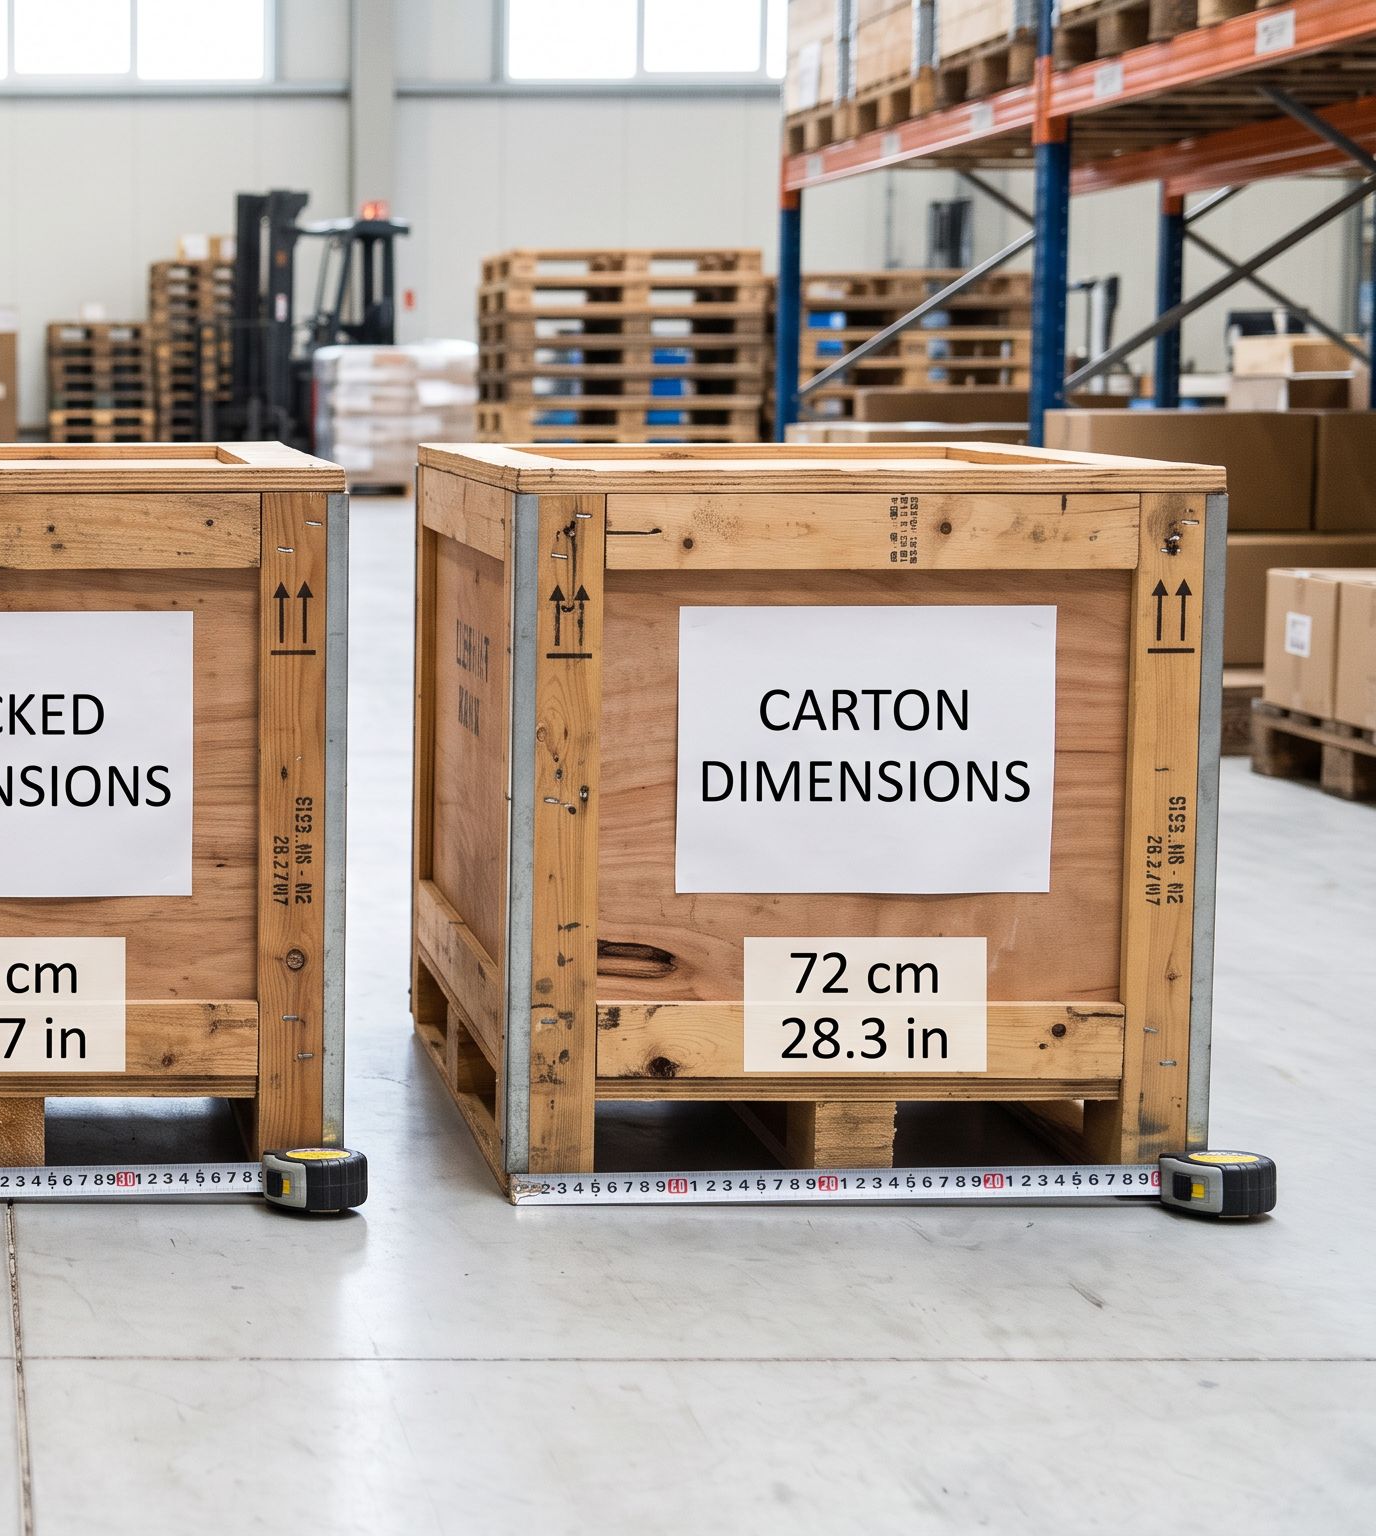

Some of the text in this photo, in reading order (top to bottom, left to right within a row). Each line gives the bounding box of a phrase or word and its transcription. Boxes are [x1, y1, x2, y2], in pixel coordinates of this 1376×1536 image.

[759, 688, 969, 732] CARTON
[701, 760, 1032, 803] DIMENSIONS
[0, 1175, 10, 1188] 2
[15, 1175, 26, 1188] 3
[31, 1175, 42, 1188] 4
[47, 1174, 58, 1187] 5
[62, 1174, 73, 1187] 6
[77, 1174, 88, 1187] 7
[93, 1173, 104, 1186] 8
[106, 1173, 116, 1186] 9
[135, 1173, 142, 1186] 1
[147, 1173, 158, 1186] 2
[163, 1172, 173, 1185] 3
[178, 1172, 190, 1185] 4
[195, 1172, 205, 1185] 5
[210, 1171, 221, 1184] 6
[226, 1171, 237, 1184] 7
[242, 1171, 253, 1184] 8
[557, 1182, 567, 1195] 3
[573, 1182, 584, 1195] 4
[590, 1182, 601, 1195] 5
[607, 1181, 618, 1194] 6
[623, 1181, 633, 1194] 7
[639, 1180, 650, 1193] 8
[655, 1180, 666, 1193] 9
[689, 1180, 697, 1193] 1
[706, 1179, 716, 1192] 2
[722, 1179, 733, 1192] 3
[738, 1179, 750, 1192] 4
[756, 1179, 767, 1192] 5
[772, 1178, 783, 1191] 7
[789, 1178, 800, 1191] 8
[805, 1178, 817, 1191] 9
[840, 1177, 847, 1190] 1
[855, 1177, 866, 1190] 2
[872, 1176, 882, 1189] 3
[888, 1176, 900, 1189] 4
[906, 1176, 916, 1189] 5
[922, 1176, 933, 1189] 6
[938, 1176, 949, 1189] 7
[955, 1175, 966, 1188] 8
[971, 1175, 982, 1188] 9
[1005, 1175, 1013, 1188] 1
[1021, 1174, 1032, 1187] 2
[1037, 1174, 1048, 1187] 3
[1054, 1174, 1066, 1187] 4
[1072, 1174, 1082, 1187] 5
[1088, 1173, 1099, 1186] 6
[1105, 1173, 1116, 1186] 7
[1122, 1173, 1133, 1186] 8
[1138, 1172, 1149, 1185] 9
